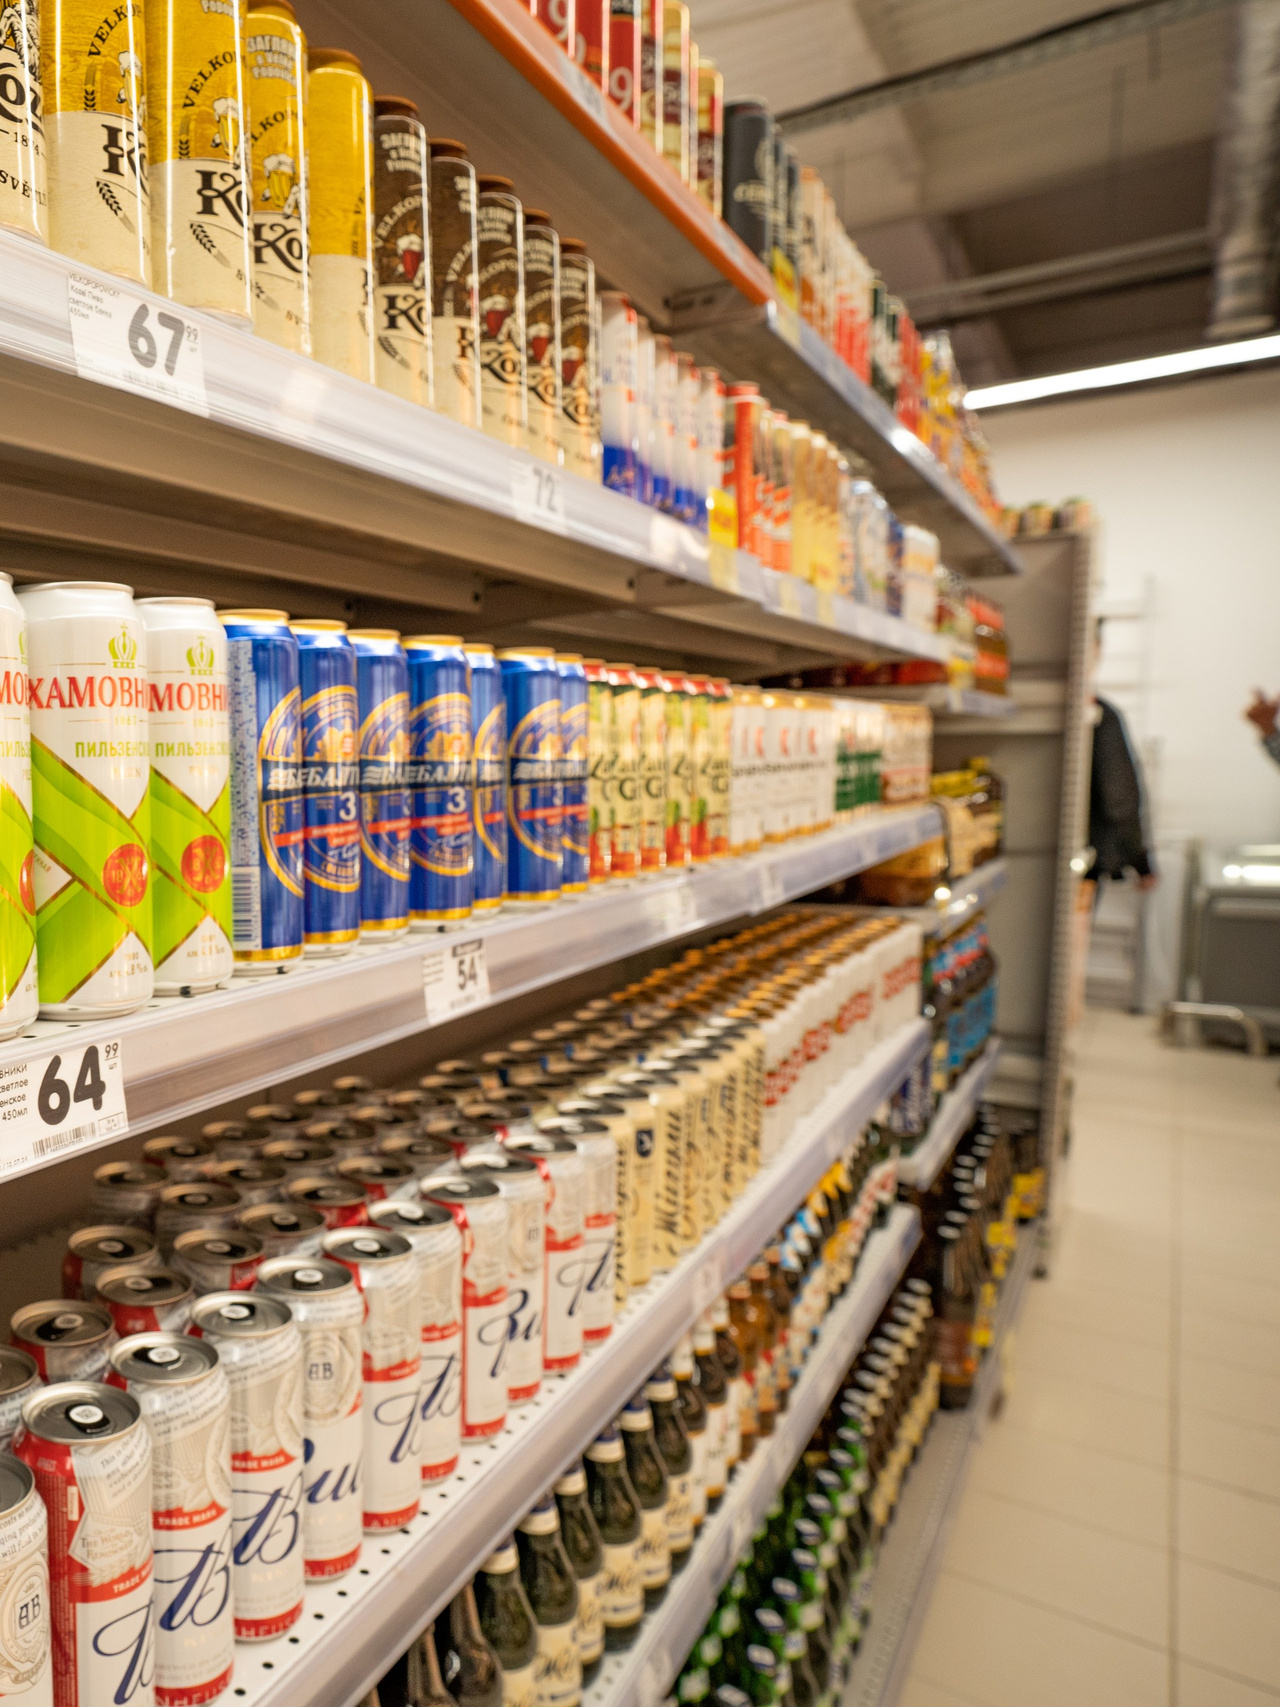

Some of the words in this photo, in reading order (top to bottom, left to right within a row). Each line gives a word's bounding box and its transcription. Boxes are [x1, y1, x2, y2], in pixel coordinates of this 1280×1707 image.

[128, 303, 185, 376] 67
[186, 325, 199, 341] 99
[339, 791, 356, 821] 3
[447, 787, 466, 813] 3
[105, 1043, 119, 1058] 99
[38, 1045, 106, 1126] 64
[2, 1107, 28, 1121] 450мл
[158, 1517, 190, 1525] TRADE
